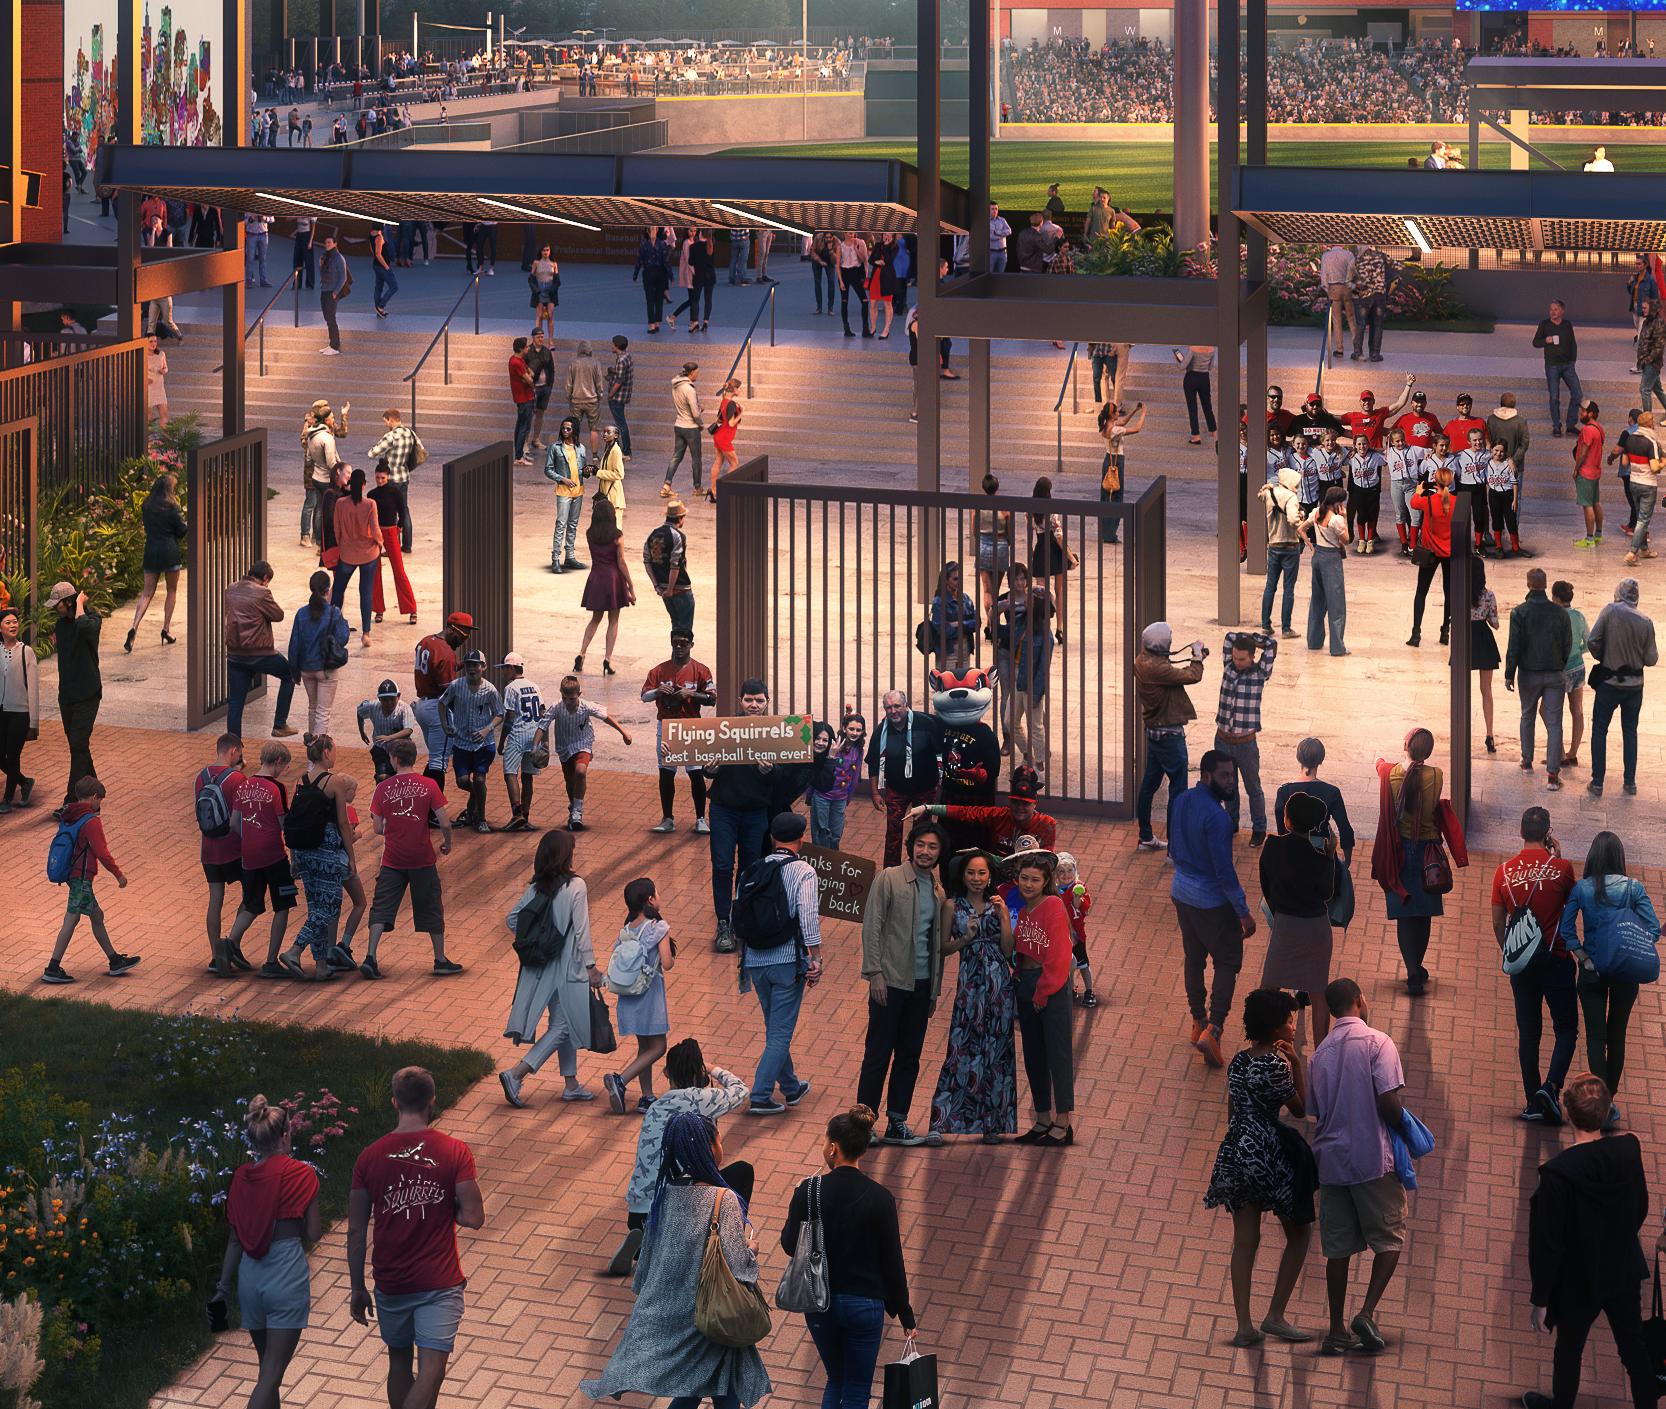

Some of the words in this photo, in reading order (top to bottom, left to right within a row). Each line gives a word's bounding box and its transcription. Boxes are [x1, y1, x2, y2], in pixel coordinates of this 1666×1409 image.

[1053, 26, 1062, 35] M
[1124, 26, 1136, 35] W
[1594, 27, 1603, 36] M
[605, 233, 639, 242] Baseball
[554, 246, 603, 255] Professional
[415, 645, 430, 675] 18
[520, 696, 540, 723] 50
[668, 722, 715, 745] Flying
[719, 720, 794, 743] Squirrels
[695, 748, 744, 761] baseball
[747, 747, 777, 760] team
[780, 745, 811, 760] ever!
[797, 853, 832, 871] anks
[841, 861, 862, 878] for
[829, 894, 860, 915] back
